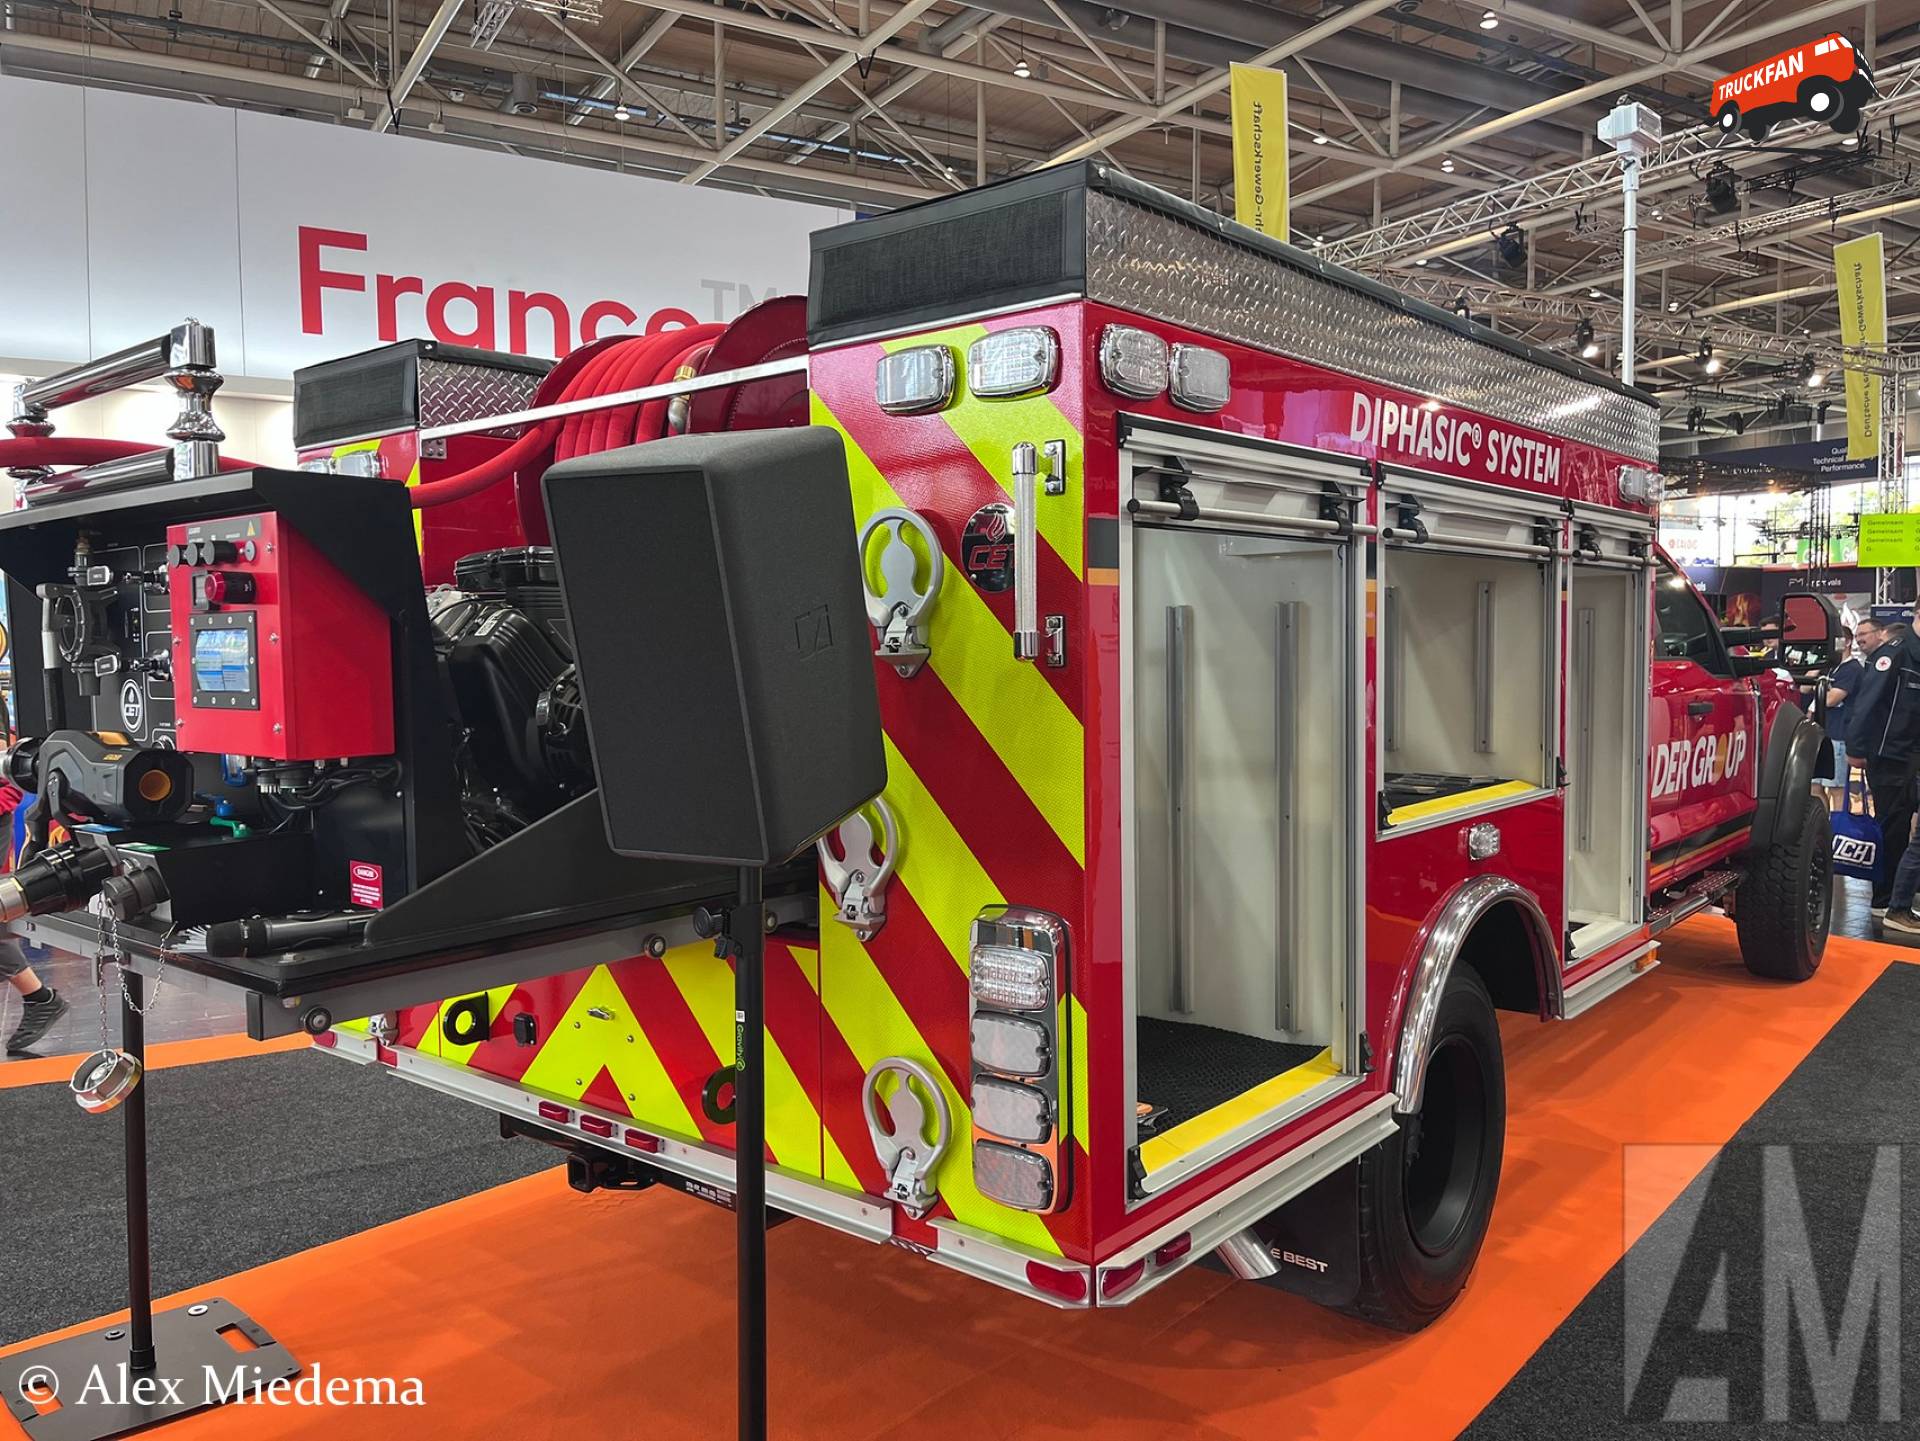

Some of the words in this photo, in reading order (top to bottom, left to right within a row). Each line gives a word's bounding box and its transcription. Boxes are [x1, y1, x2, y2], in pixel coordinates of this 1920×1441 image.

[1485, 429, 1561, 486] SYSTEM
[1813, 455, 1844, 465] Technical
[968, 543, 1015, 571] CE
[1650, 741, 1691, 799] DER
[1692, 730, 1747, 788] GROUP
[1283, 1251, 1329, 1273] BEST
